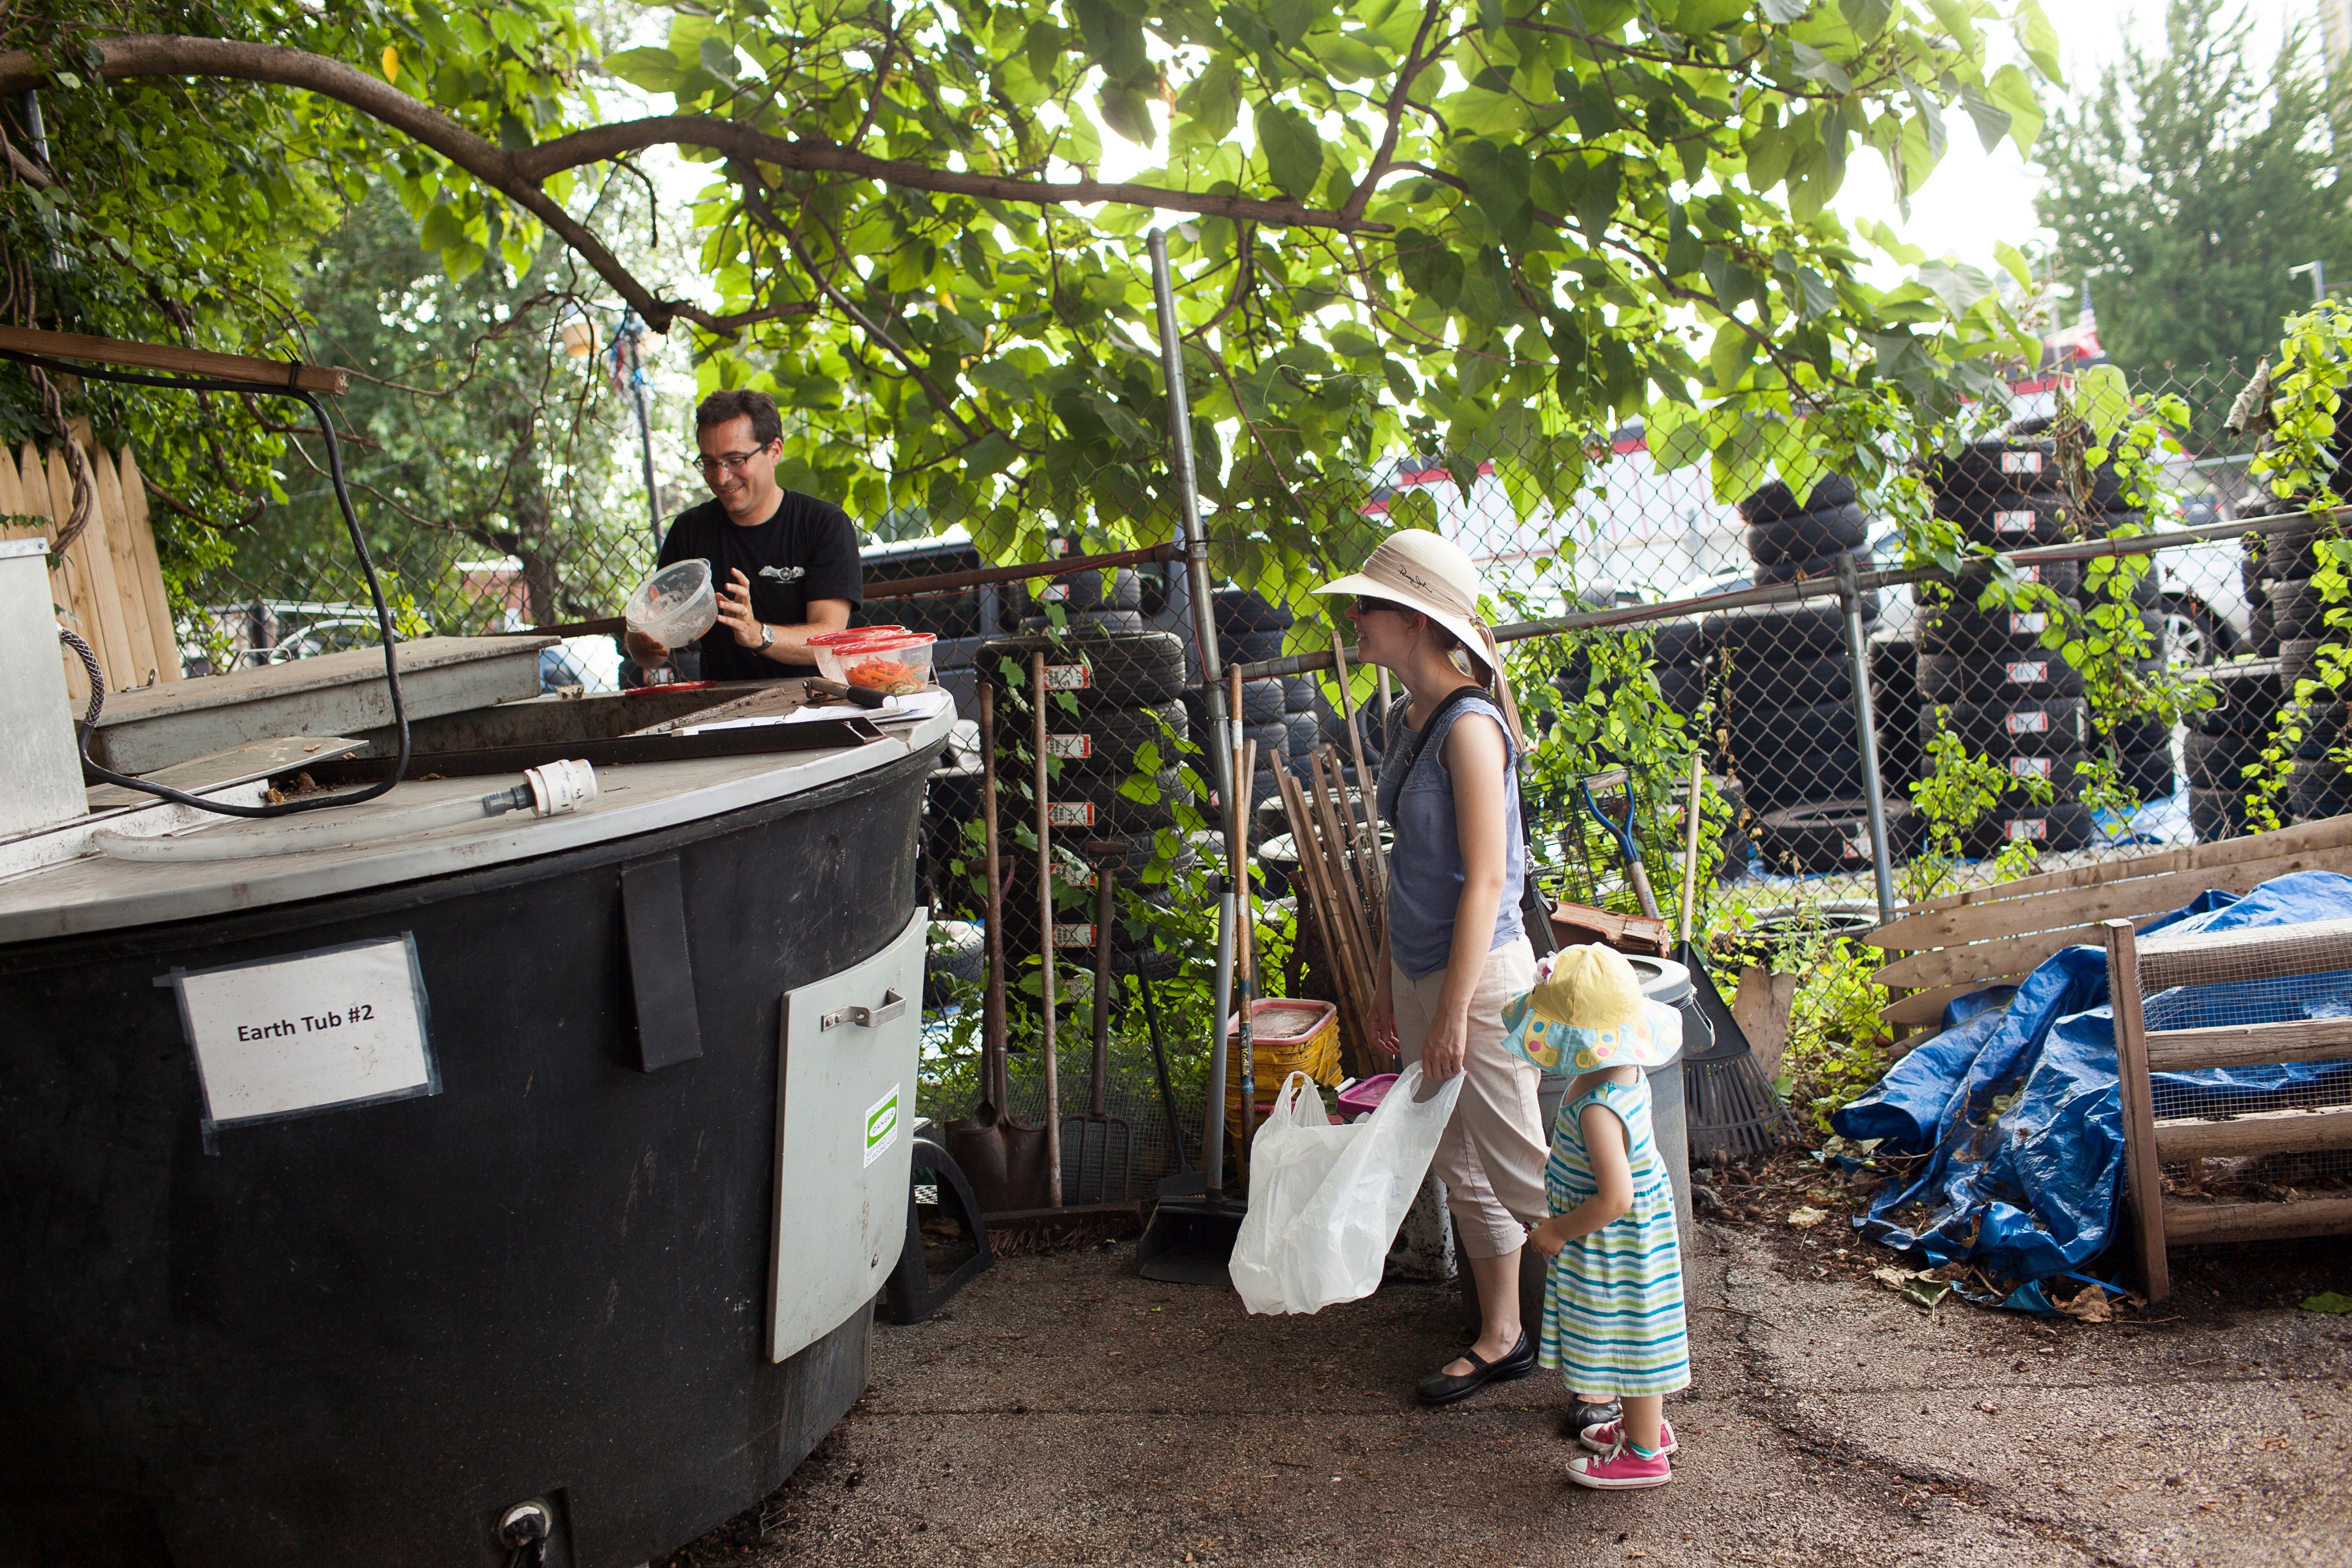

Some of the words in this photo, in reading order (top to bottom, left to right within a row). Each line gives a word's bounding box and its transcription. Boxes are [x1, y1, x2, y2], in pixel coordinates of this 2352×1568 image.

[237, 1019, 296, 1042] Earth
[301, 1010, 342, 1033] Tub
[348, 1004, 375, 1024] #2
[1241, 1048, 1250, 1077] Kodiak
[872, 1109, 894, 1134] DANGER
[866, 1147, 875, 1158] KEEP
[875, 1137, 887, 1149] HANDS
[872, 1143, 887, 1159] MOVING
